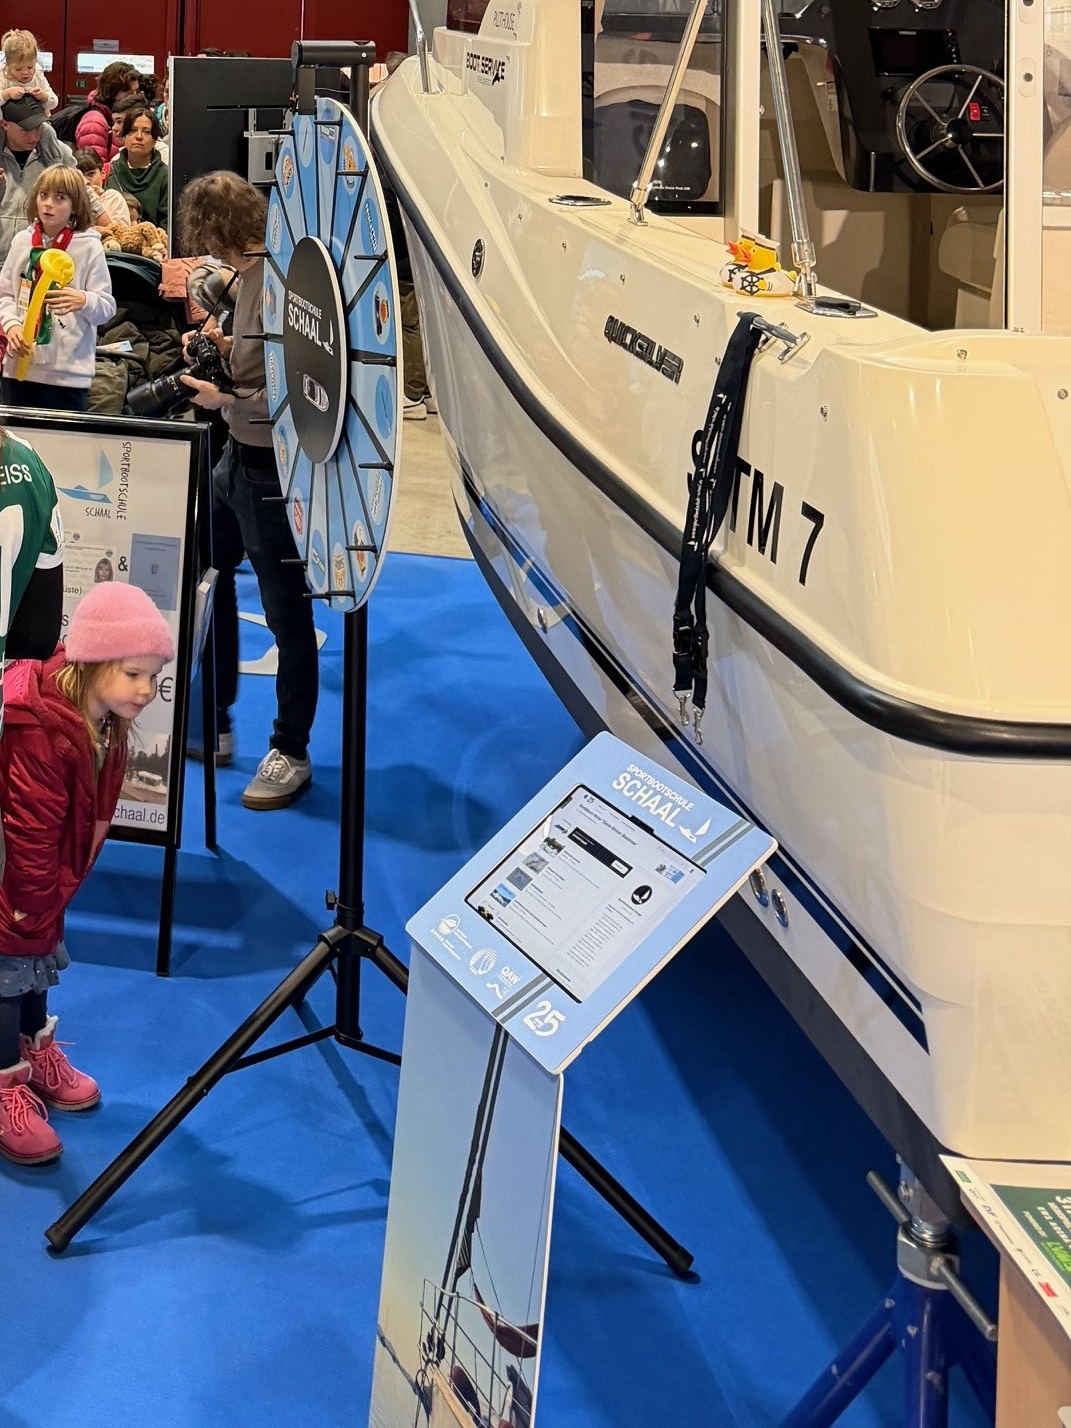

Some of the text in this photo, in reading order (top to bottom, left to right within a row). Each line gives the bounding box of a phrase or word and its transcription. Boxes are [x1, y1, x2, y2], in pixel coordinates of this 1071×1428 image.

[288, 303, 322, 347] SCHAAL
[116, 441, 132, 520] SPORTBOOTSCHULE
[85, 507, 112, 519] SCHAAL
[117, 556, 129, 572] &
[800, 500, 825, 586] 7
[612, 772, 682, 828] SCHAAL
[626, 763, 695, 812] SPORTBOOTSCHULE
[523, 1000, 567, 1037] 25
